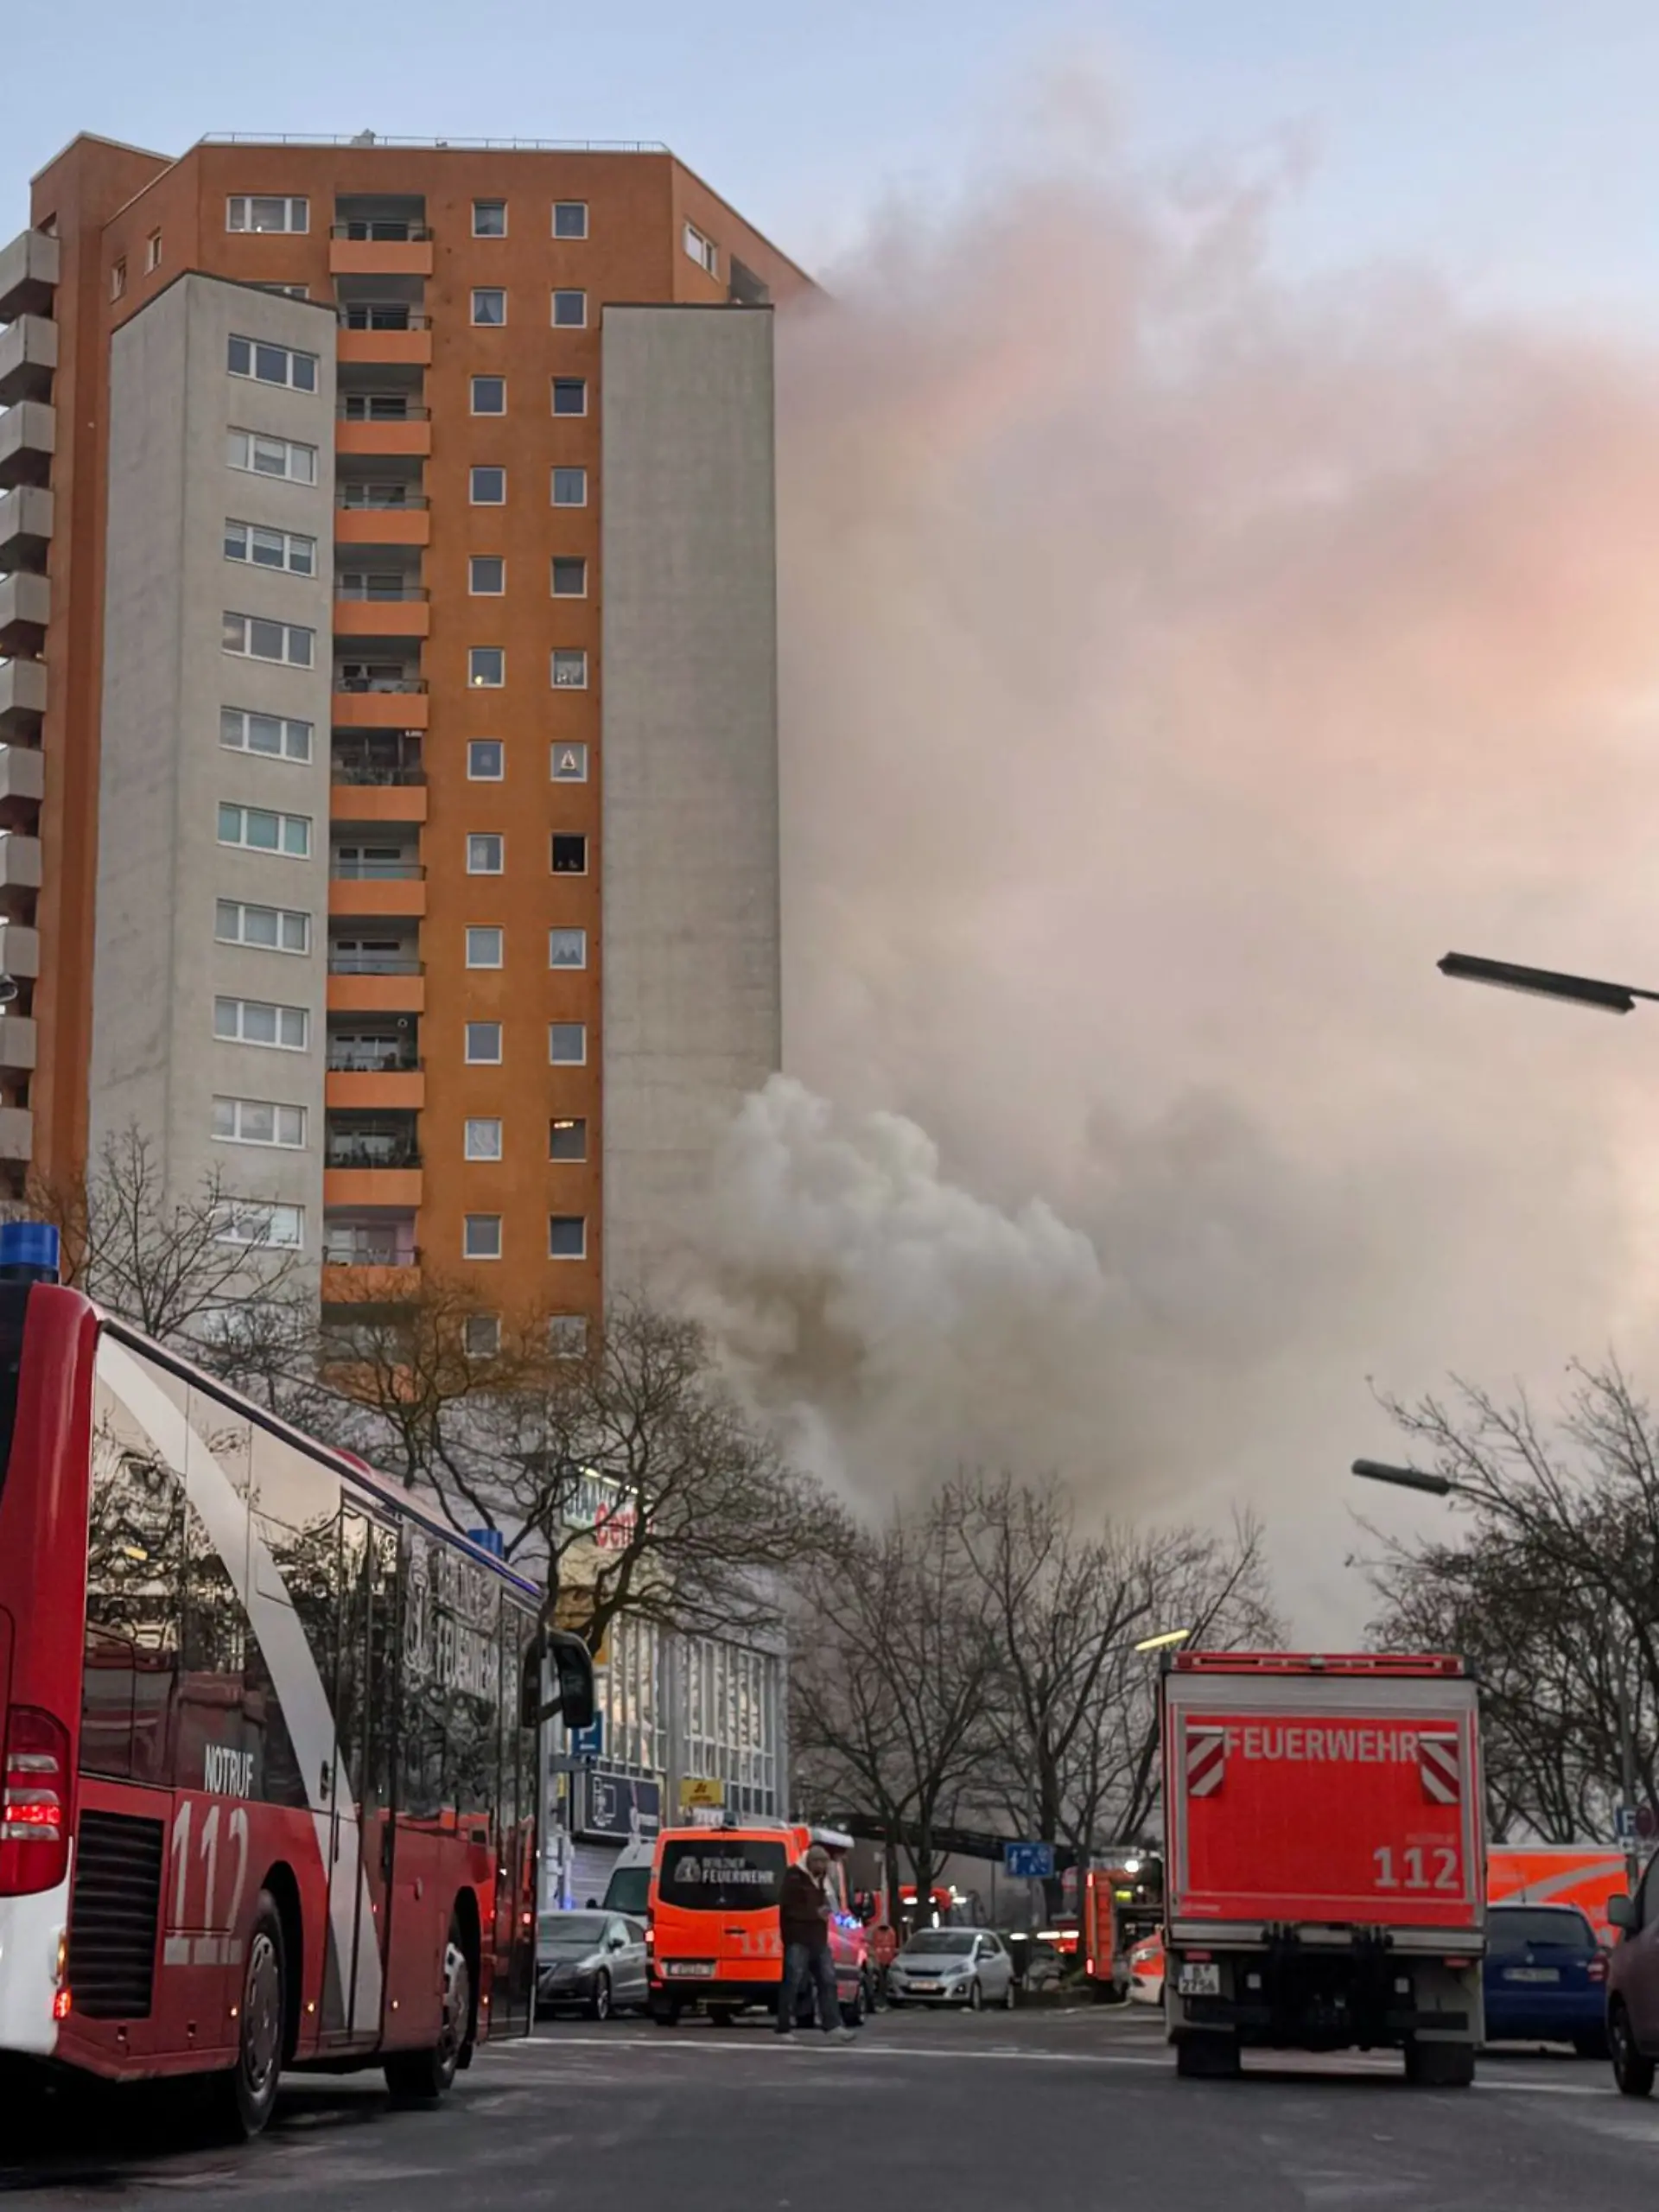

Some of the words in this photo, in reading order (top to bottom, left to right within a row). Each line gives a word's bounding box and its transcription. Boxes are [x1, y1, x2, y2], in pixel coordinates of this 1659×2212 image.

[1224, 1726, 1420, 1763] FEUERWEHR
[204, 1744, 254, 1799] NOTRUF
[164, 1801, 249, 1966] 112
[702, 1869, 774, 1884] FEUERWEHR
[1373, 1847, 1459, 1891] 112
